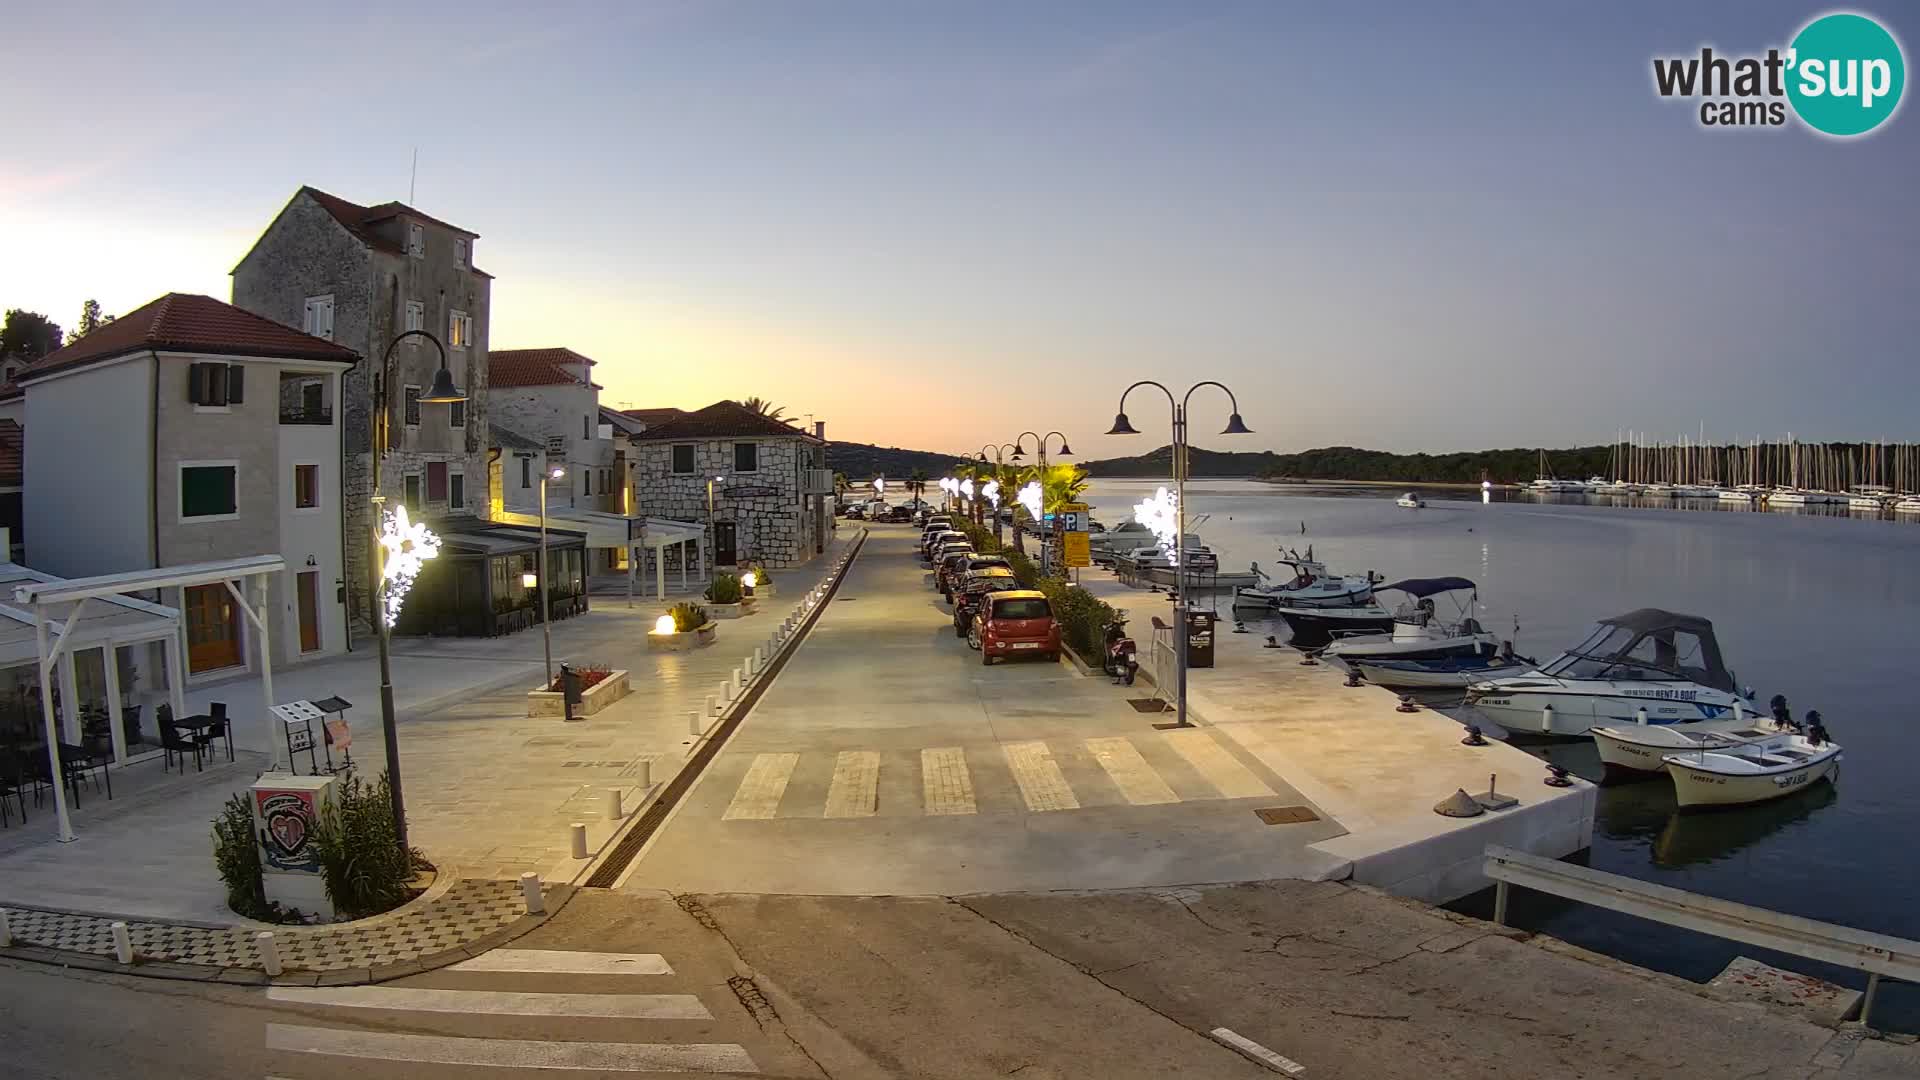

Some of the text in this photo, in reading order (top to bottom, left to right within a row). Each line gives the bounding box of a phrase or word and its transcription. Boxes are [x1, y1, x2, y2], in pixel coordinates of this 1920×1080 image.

[1065, 514, 1076, 530] P
[1655, 689, 1673, 699] RENT
[1680, 690, 1697, 701] BOAT
